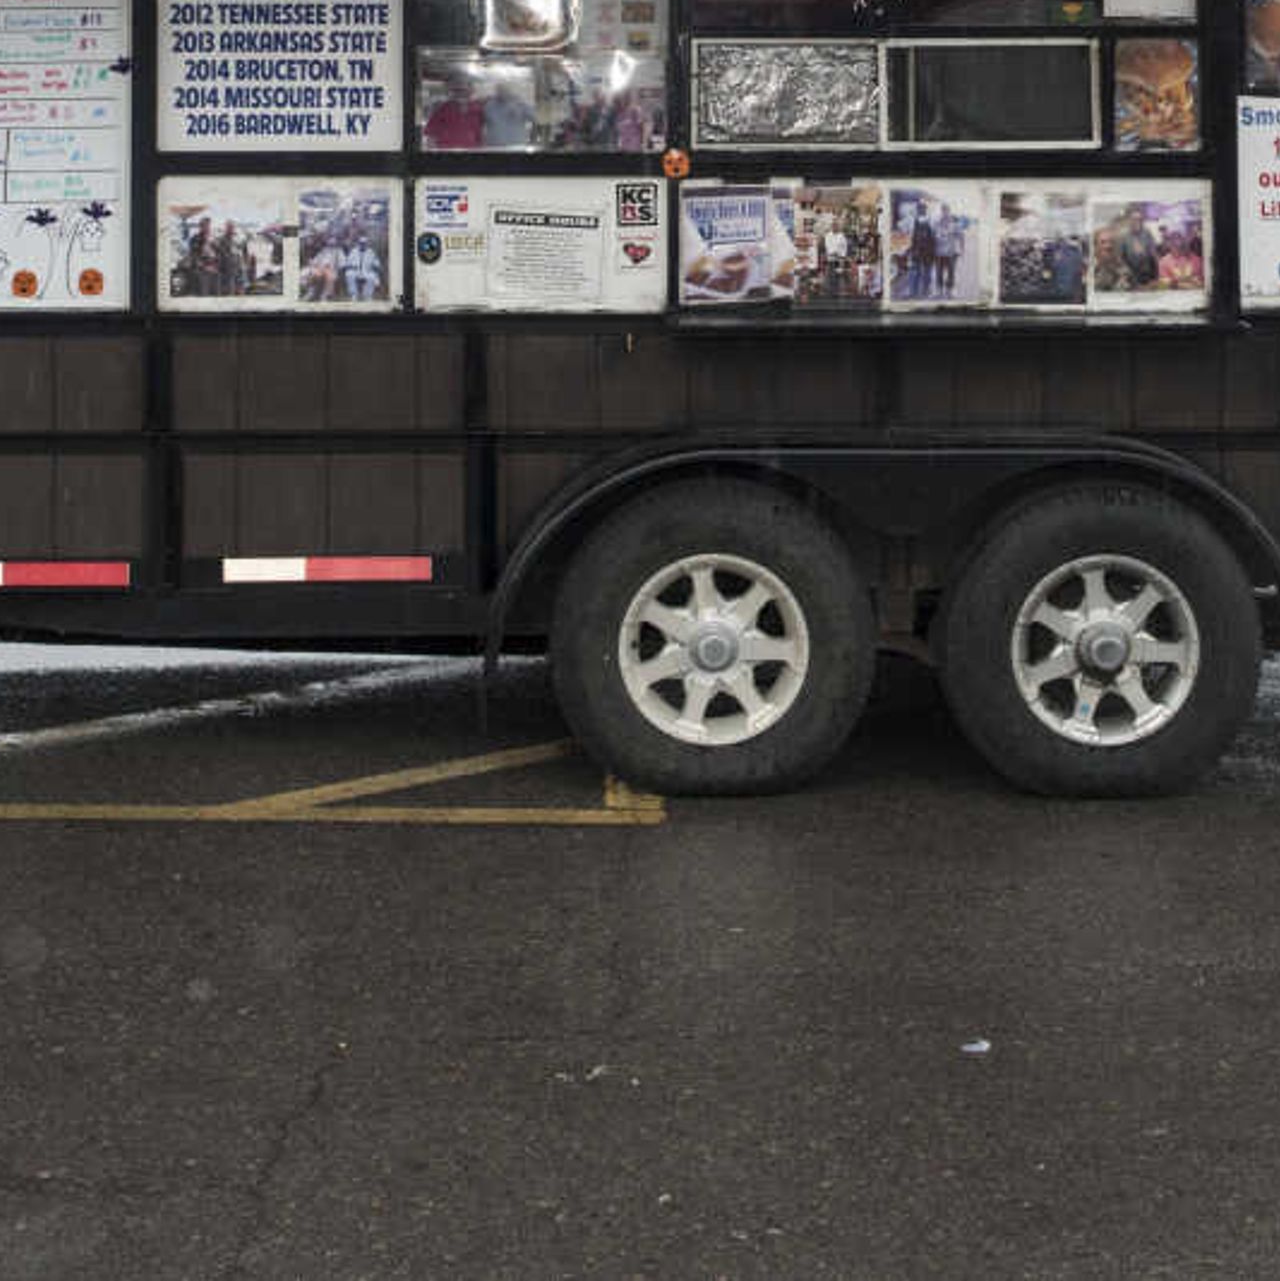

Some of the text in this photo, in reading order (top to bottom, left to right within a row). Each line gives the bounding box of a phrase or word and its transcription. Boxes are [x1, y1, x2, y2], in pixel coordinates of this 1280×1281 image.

[168, 2, 389, 26] 2012 TENNESSEE STATE
[171, 30, 387, 54] 2013 ARKANSAS STATE
[184, 58, 375, 84] 2014 BRUCETON, TN
[174, 86, 384, 109] 2014 MISSOURI STATE
[186, 113, 371, 138] 2016 BARDWELL, KY
[621, 188, 652, 205] KC
